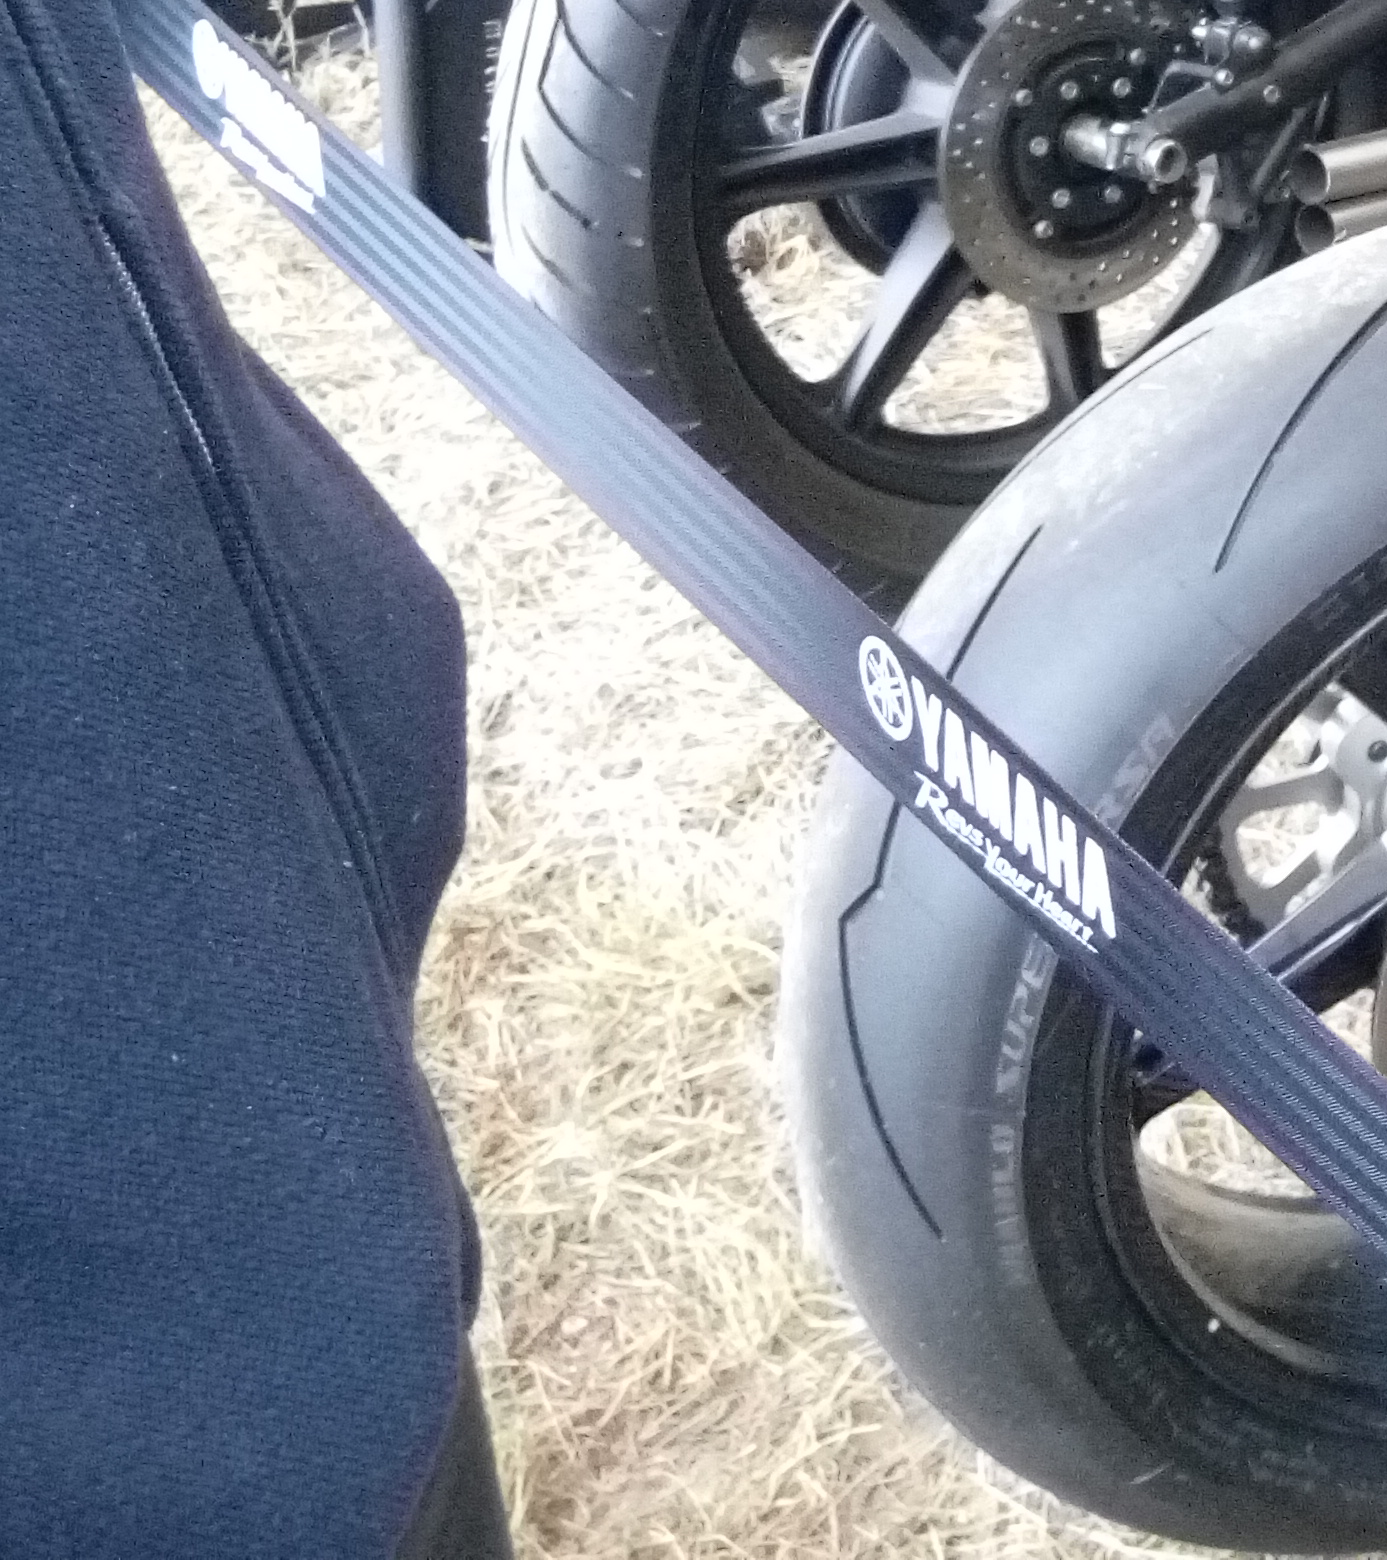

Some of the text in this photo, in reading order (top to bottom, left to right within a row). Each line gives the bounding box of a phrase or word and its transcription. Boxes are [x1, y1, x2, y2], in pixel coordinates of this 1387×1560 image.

[910, 674, 1117, 940] YAMAHA
[912, 770, 1096, 940] Revs Your Heart
